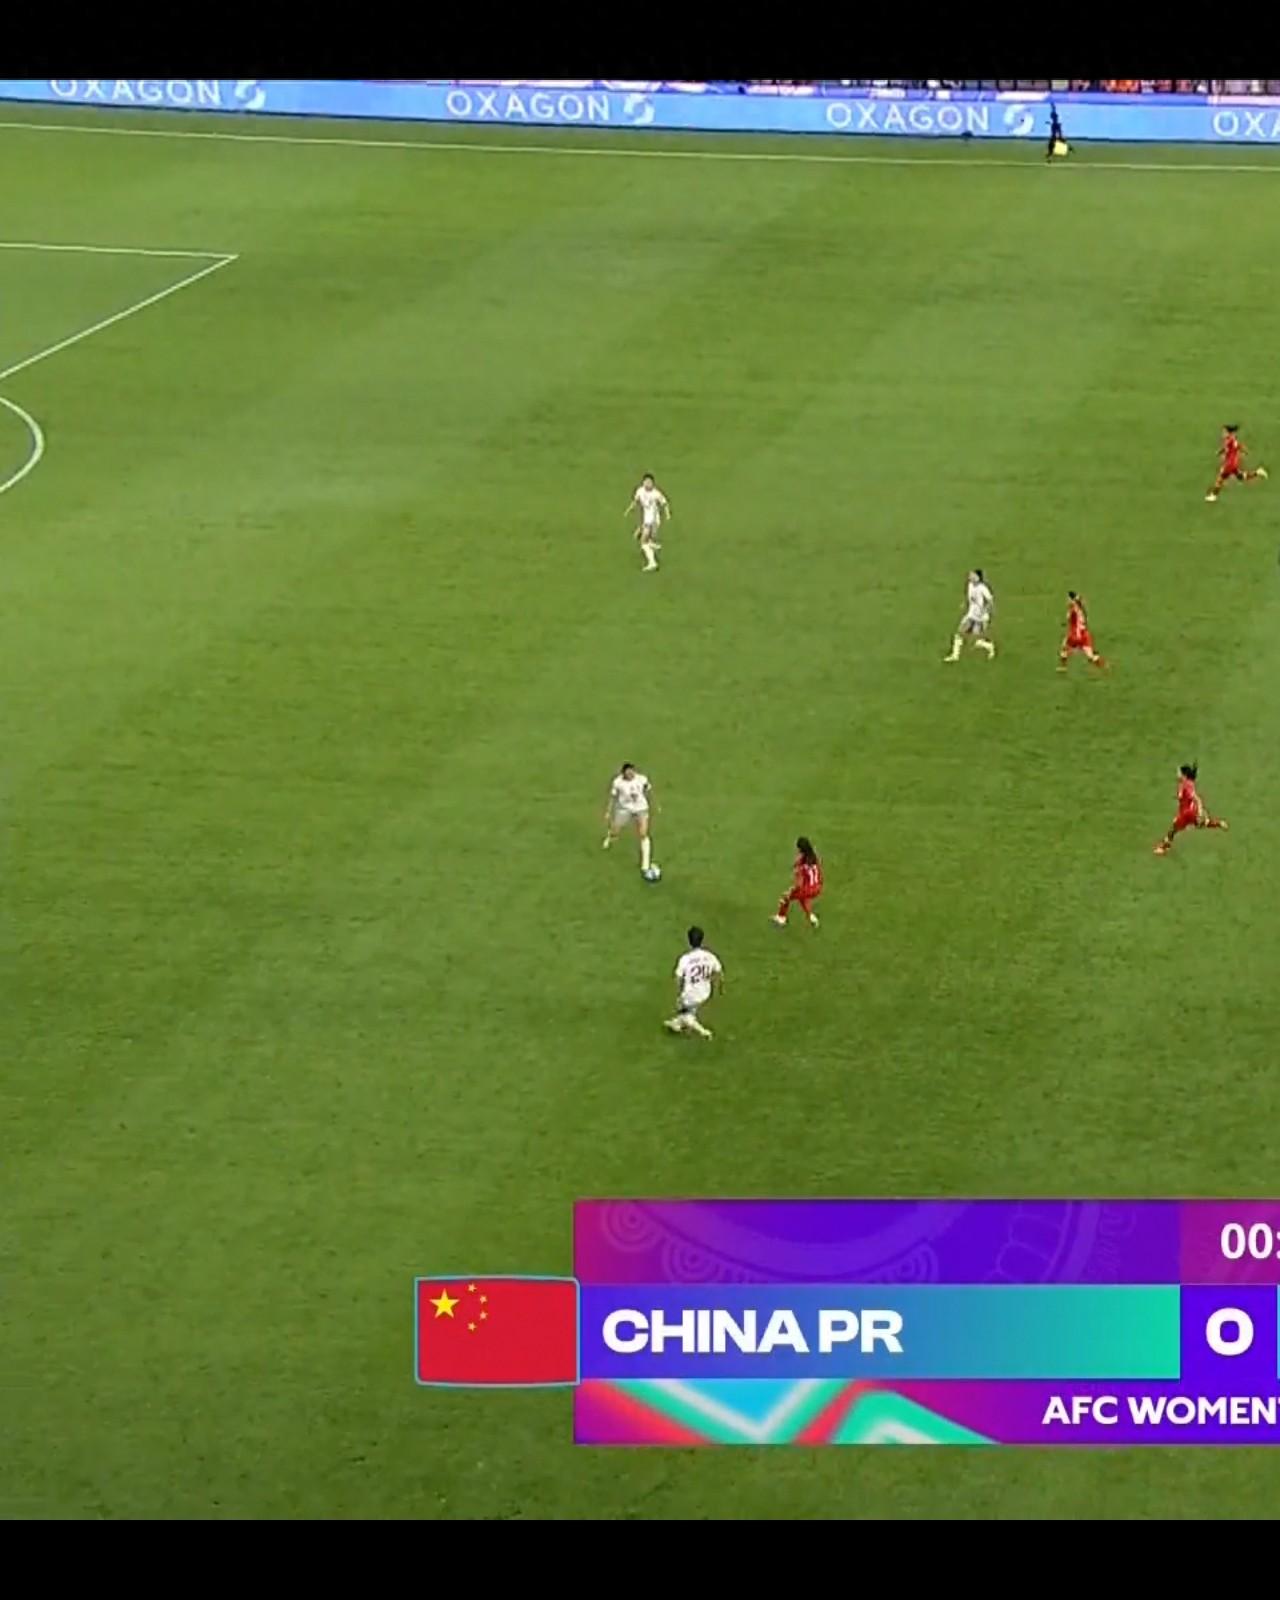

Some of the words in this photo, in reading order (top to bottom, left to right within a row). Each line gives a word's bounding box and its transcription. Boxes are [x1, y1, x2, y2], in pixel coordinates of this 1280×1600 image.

[50, 80, 222, 106] OXAGON
[446, 90, 610, 121] OXAGON
[826, 102, 989, 132] OXAGON
